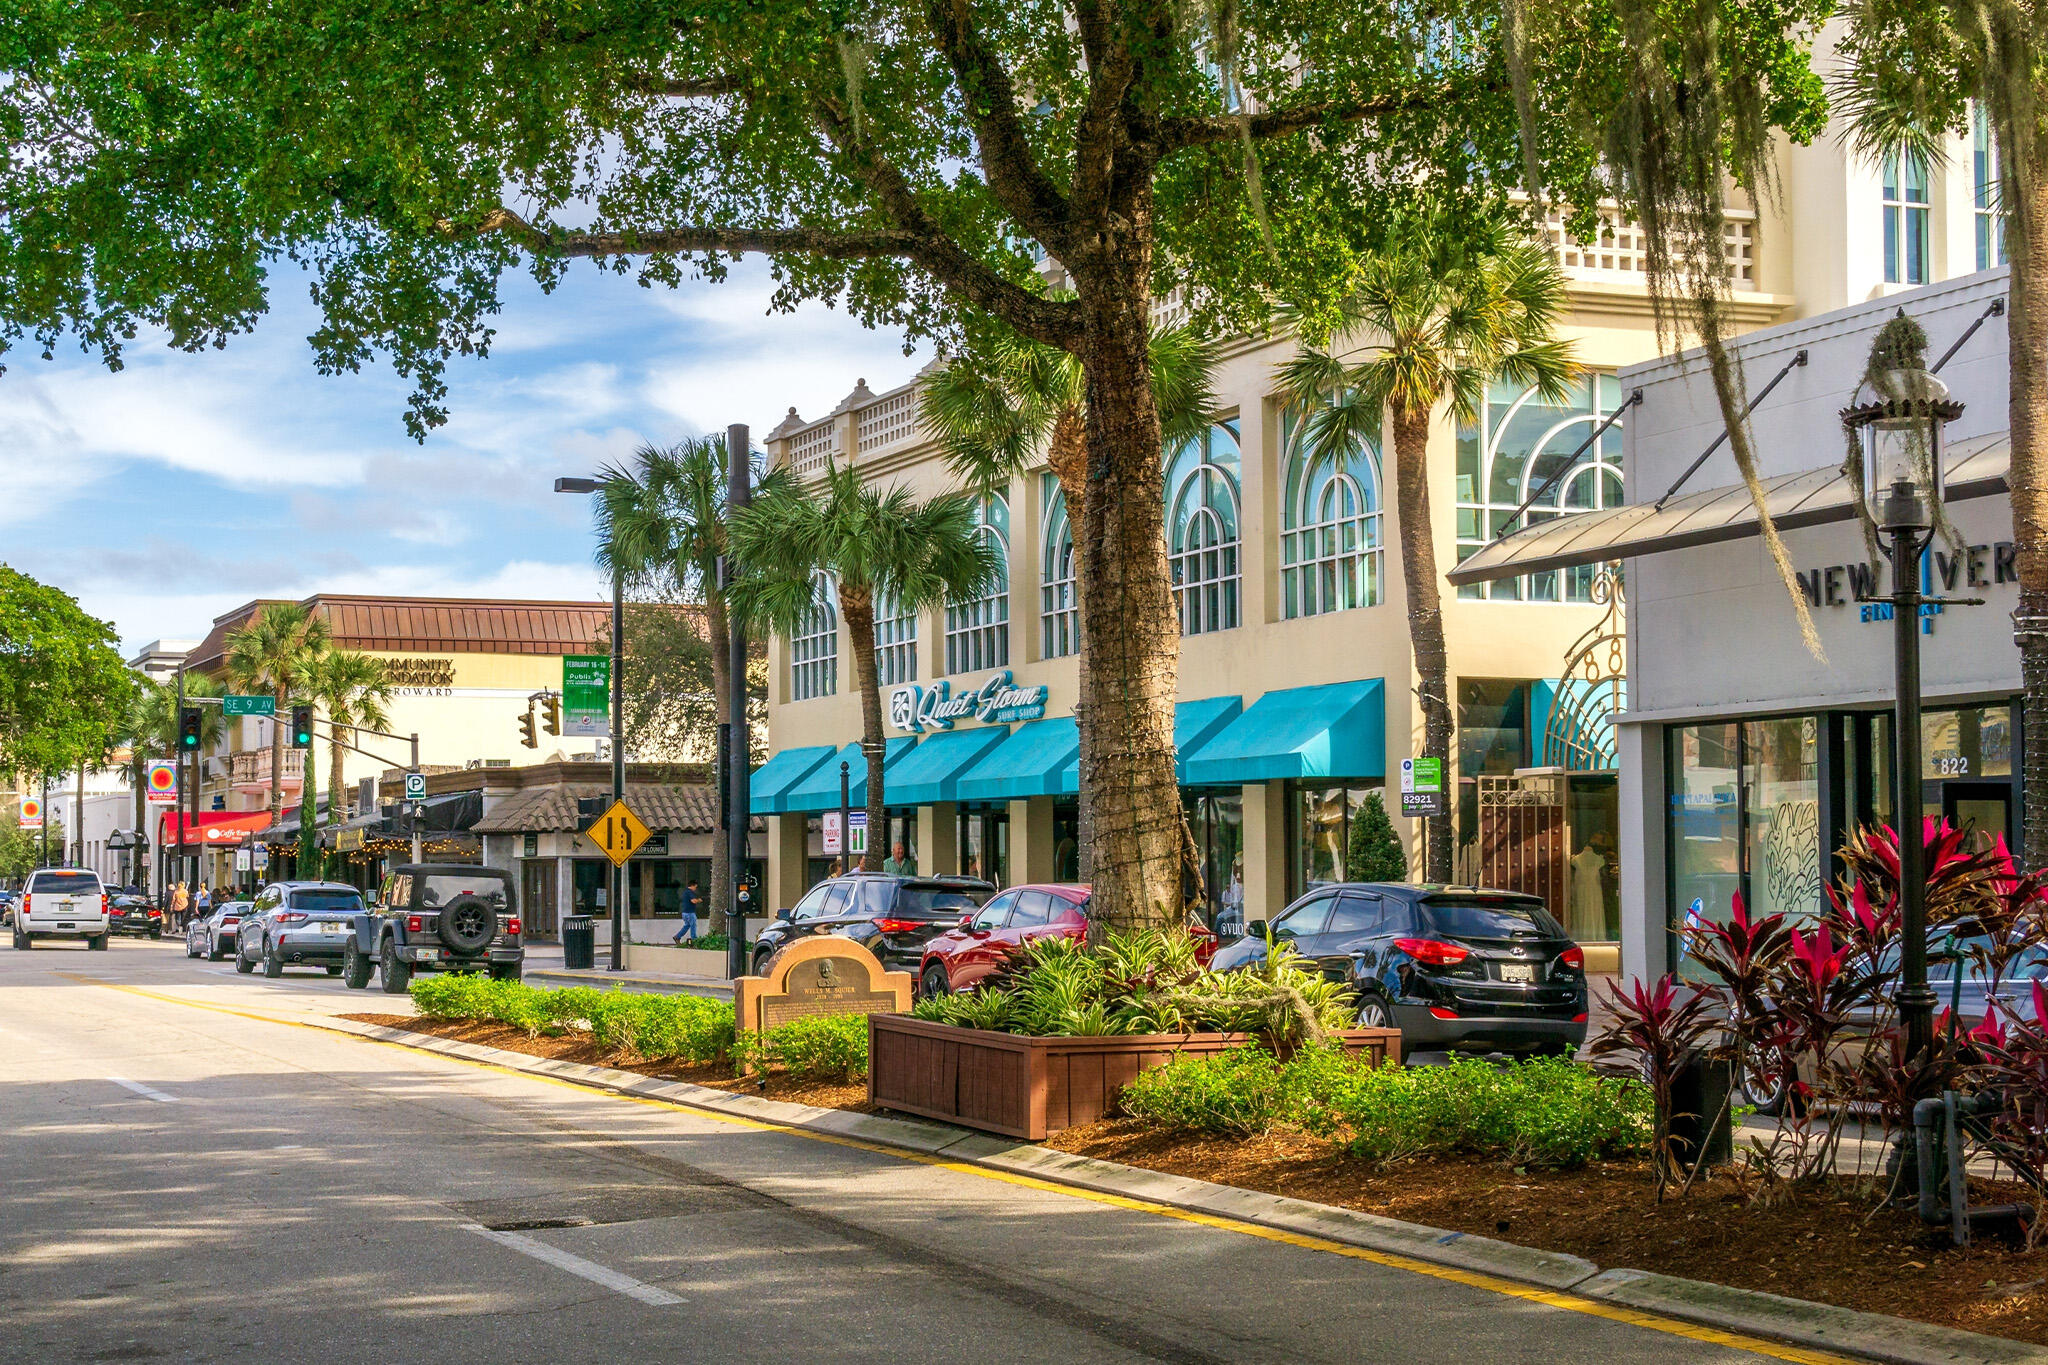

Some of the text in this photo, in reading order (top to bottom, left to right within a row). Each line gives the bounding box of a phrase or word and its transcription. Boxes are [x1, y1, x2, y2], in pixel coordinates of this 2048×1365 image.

[1796, 540, 2018, 607] NEW IVER
[1861, 602, 1901, 623] FIN
[566, 661, 590, 669] FEBRUARY
[388, 686, 453, 697] ROWARD
[226, 699, 273, 710] SE 9 AV
[917, 672, 1042, 728] Quiet Storm
[998, 706, 1041, 720] SURF SHOP
[1941, 757, 1969, 775] 822
[1403, 795, 1432, 804] 82921
